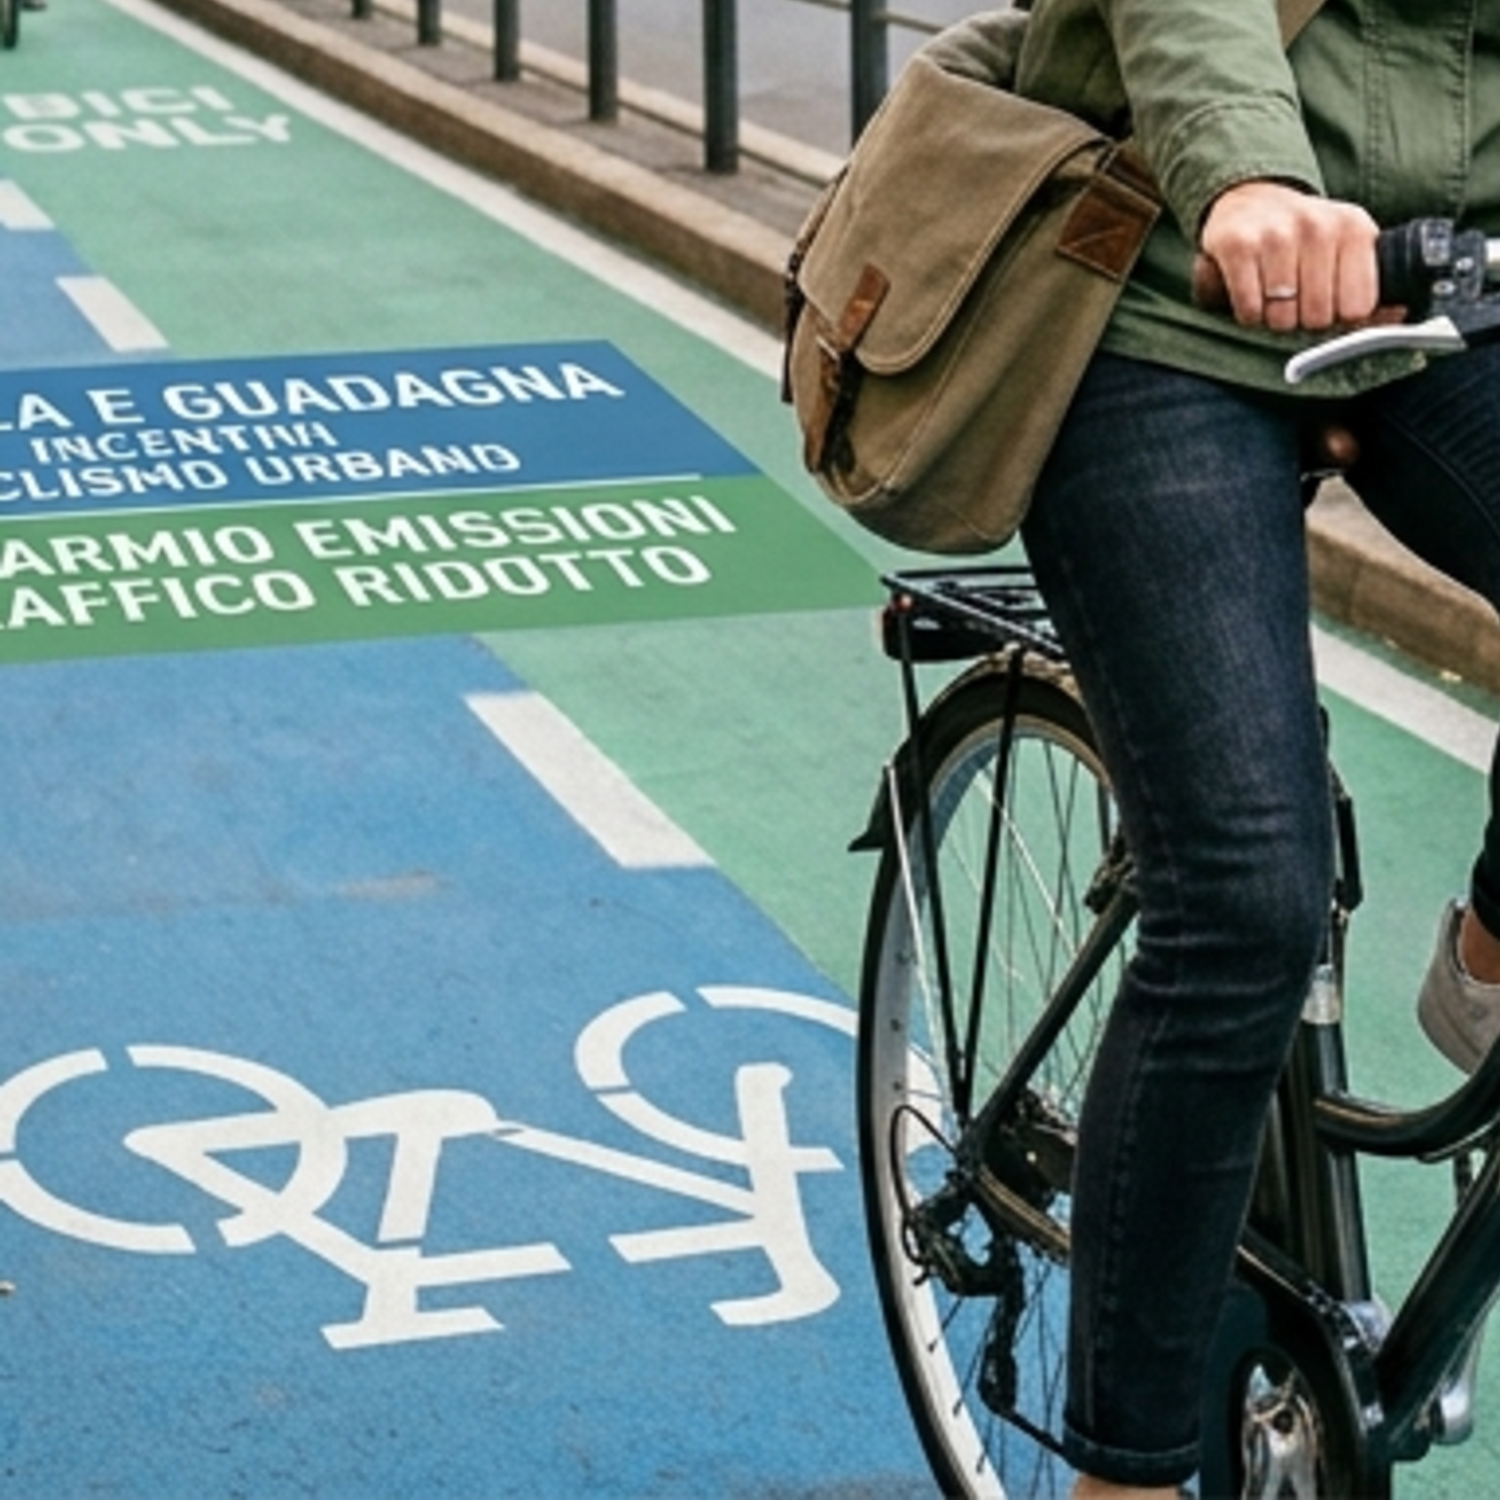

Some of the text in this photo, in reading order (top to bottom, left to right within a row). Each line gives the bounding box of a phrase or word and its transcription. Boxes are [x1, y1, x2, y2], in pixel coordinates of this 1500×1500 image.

[4, 87, 233, 119] BICI
[3, 115, 290, 151] ONLY
[0, 362, 625, 431] A E GUADAGNA
[245, 443, 521, 485] URBANO
[0, 495, 736, 579] ARMIO EMISSIONI
[0, 545, 712, 629] AFFICO RIDOTTO
